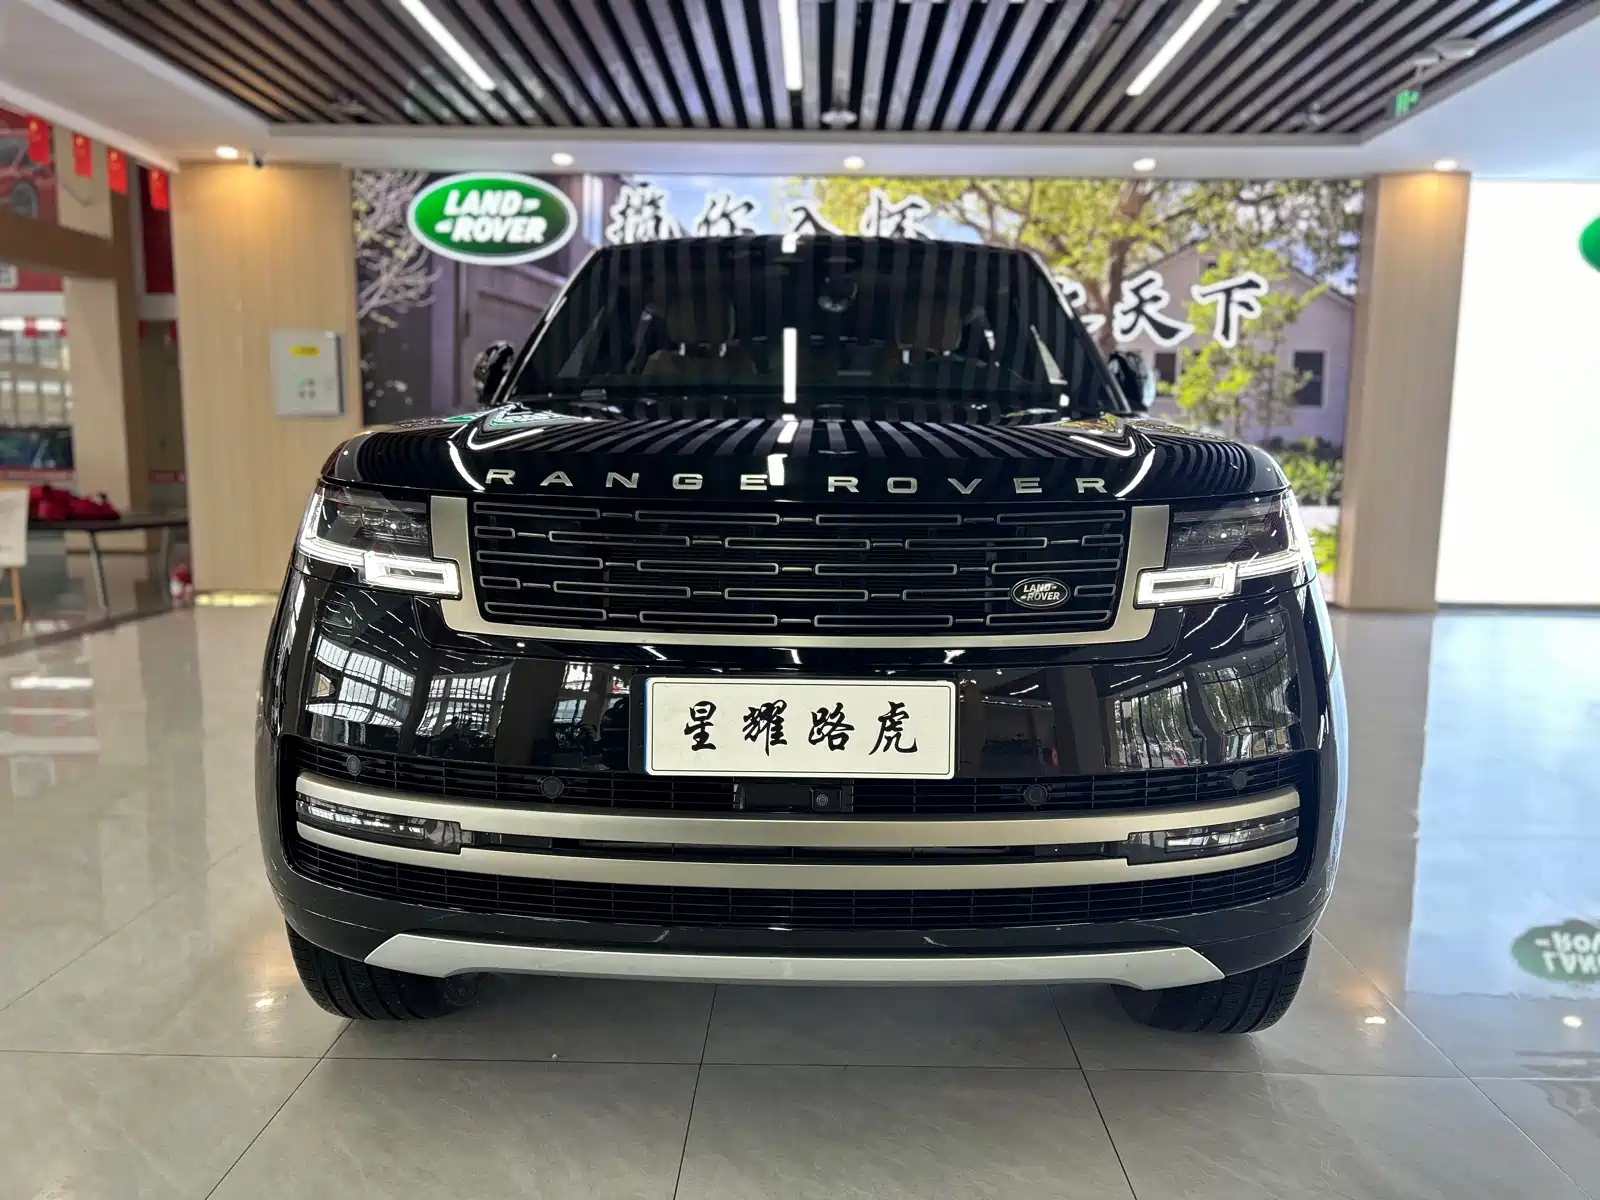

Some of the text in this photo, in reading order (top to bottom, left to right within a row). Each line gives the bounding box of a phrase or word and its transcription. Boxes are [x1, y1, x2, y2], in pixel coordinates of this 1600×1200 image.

[484, 468, 1109, 495] RANGE ROVER
[683, 699, 919, 757] 星耀路虎
